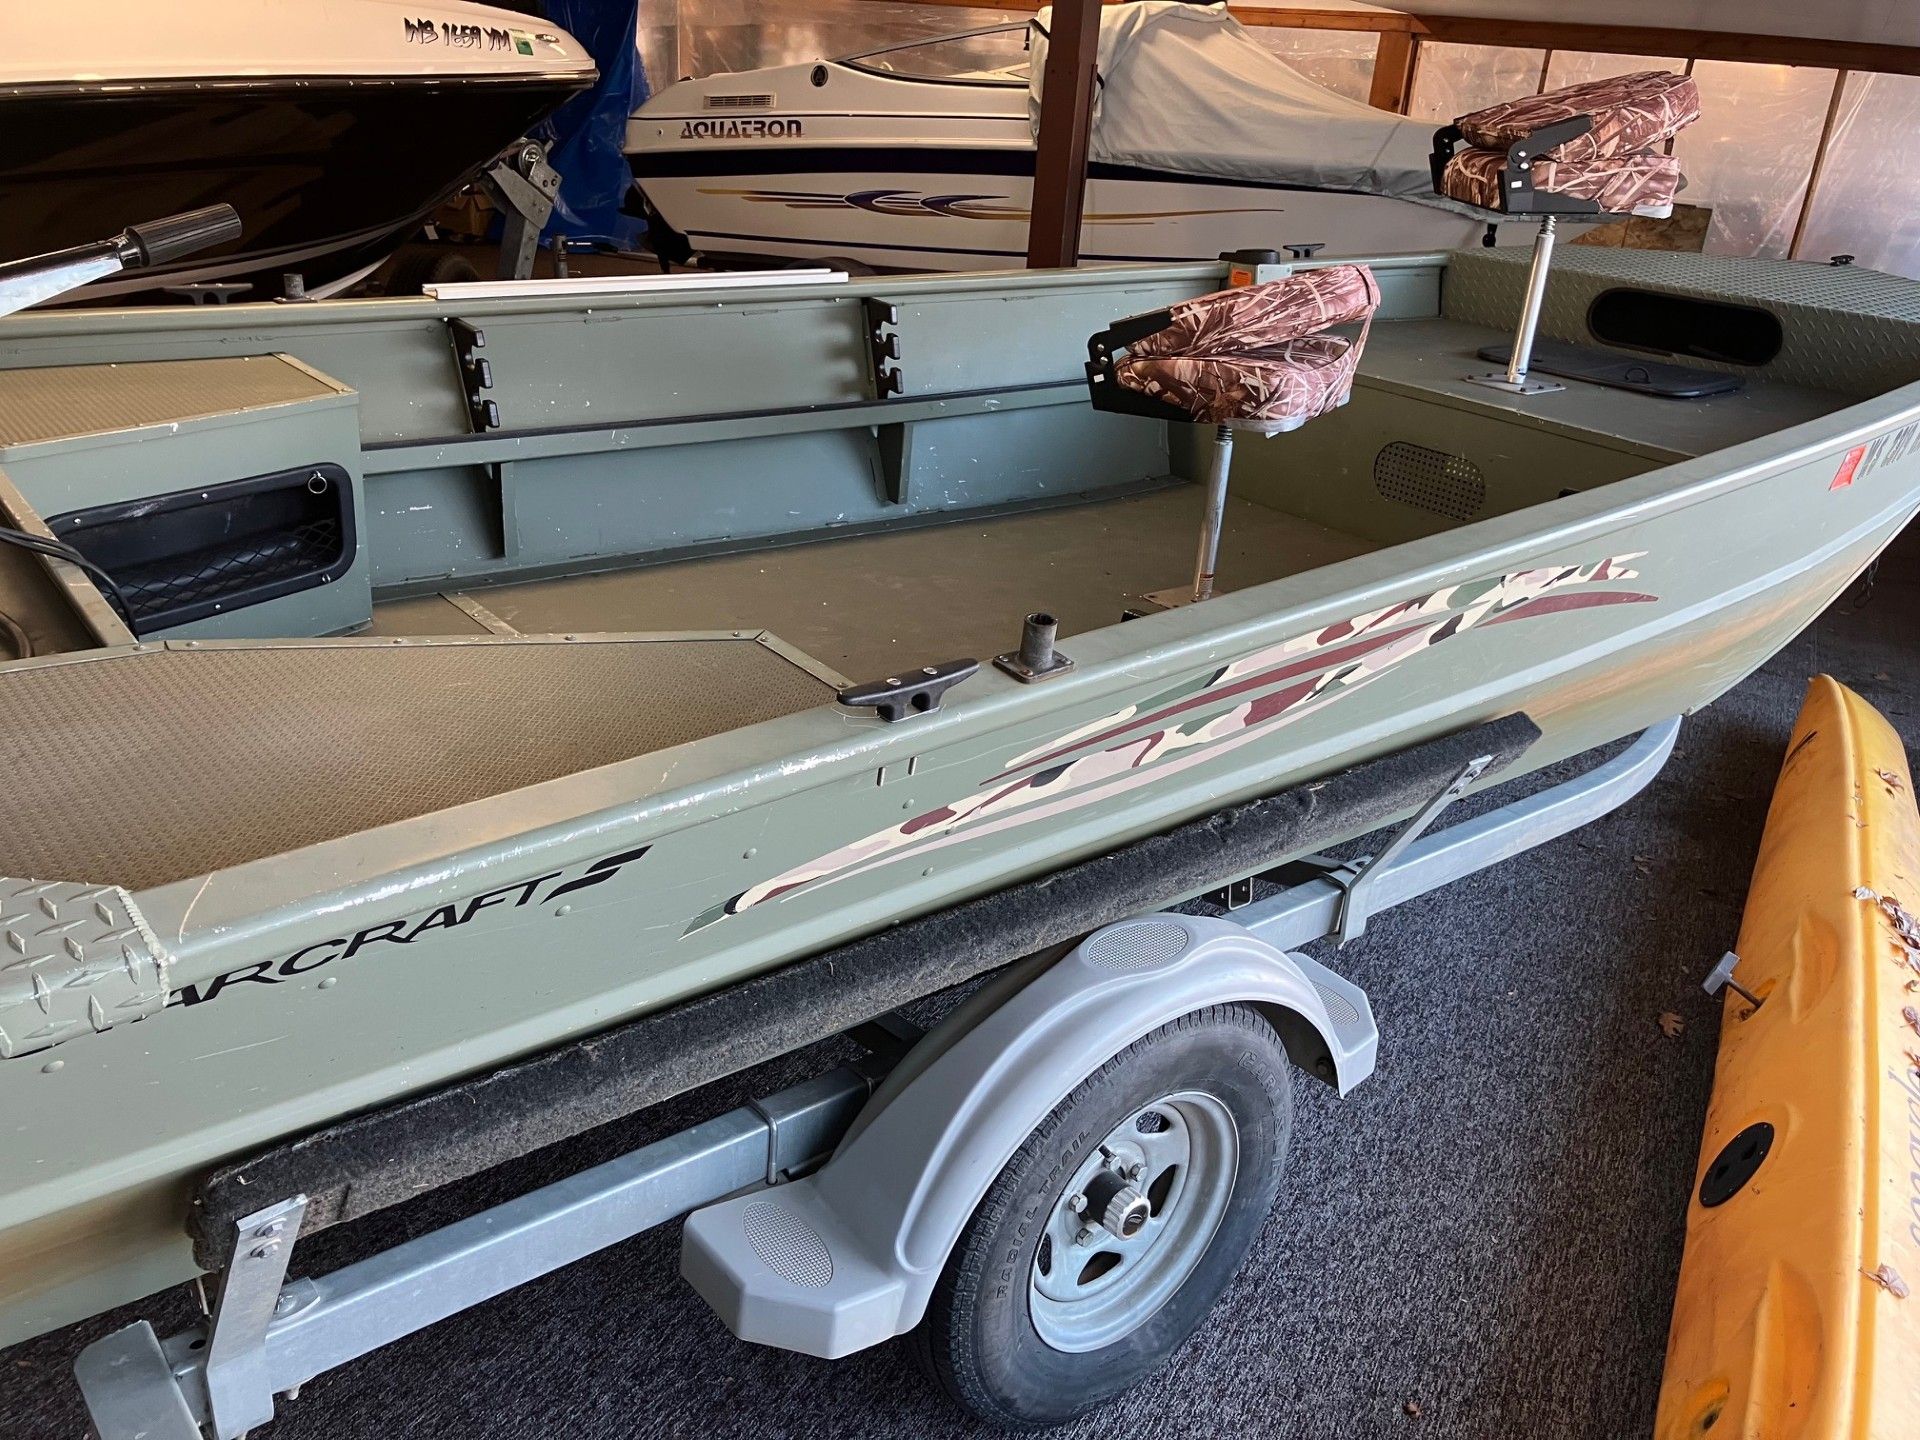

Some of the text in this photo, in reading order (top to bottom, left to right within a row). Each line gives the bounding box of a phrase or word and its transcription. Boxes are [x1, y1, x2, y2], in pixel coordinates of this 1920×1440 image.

[679, 119, 803, 140] AQUATRON
[996, 1130, 1092, 1300] RADIAL TRAIL
